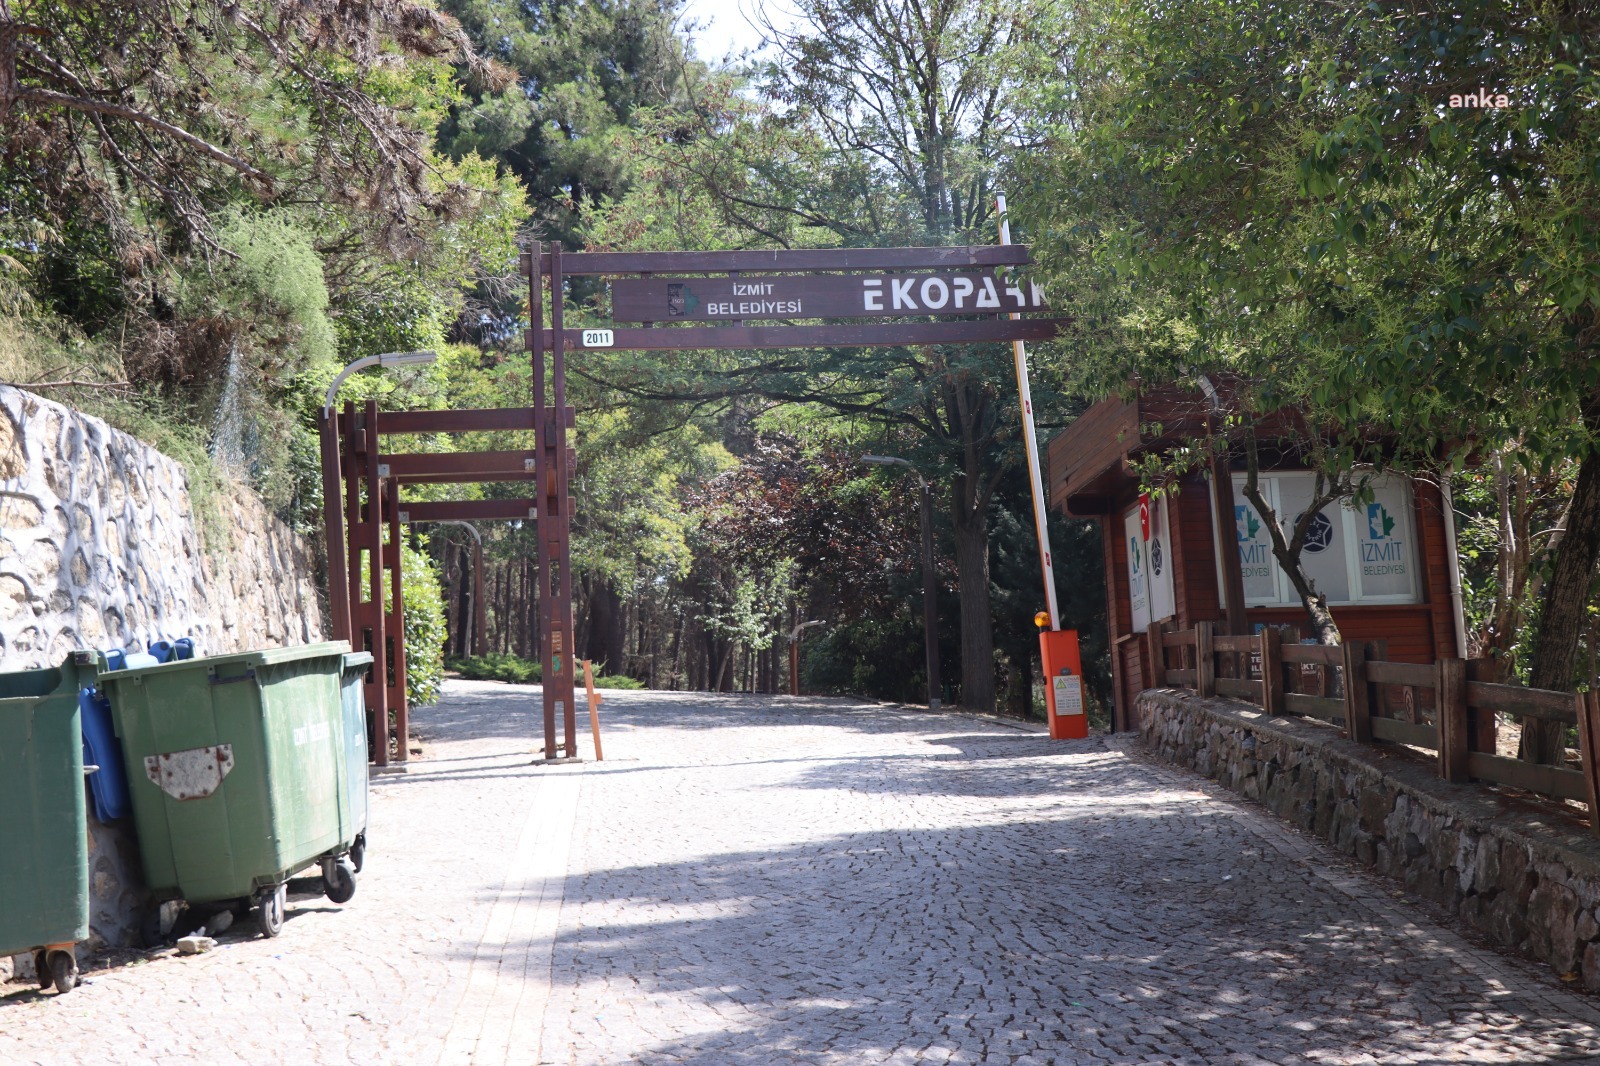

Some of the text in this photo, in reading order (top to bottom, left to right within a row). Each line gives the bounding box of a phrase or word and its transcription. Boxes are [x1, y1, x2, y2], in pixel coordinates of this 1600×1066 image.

[732, 282, 775, 297] İZMİT
[707, 299, 803, 315] BELEDİYESİ
[587, 332, 609, 344] 2011
[1239, 540, 1267, 564] MİT
[1361, 538, 1402, 562] İZMİT
[1363, 563, 1406, 576] BELEDİYESİ
